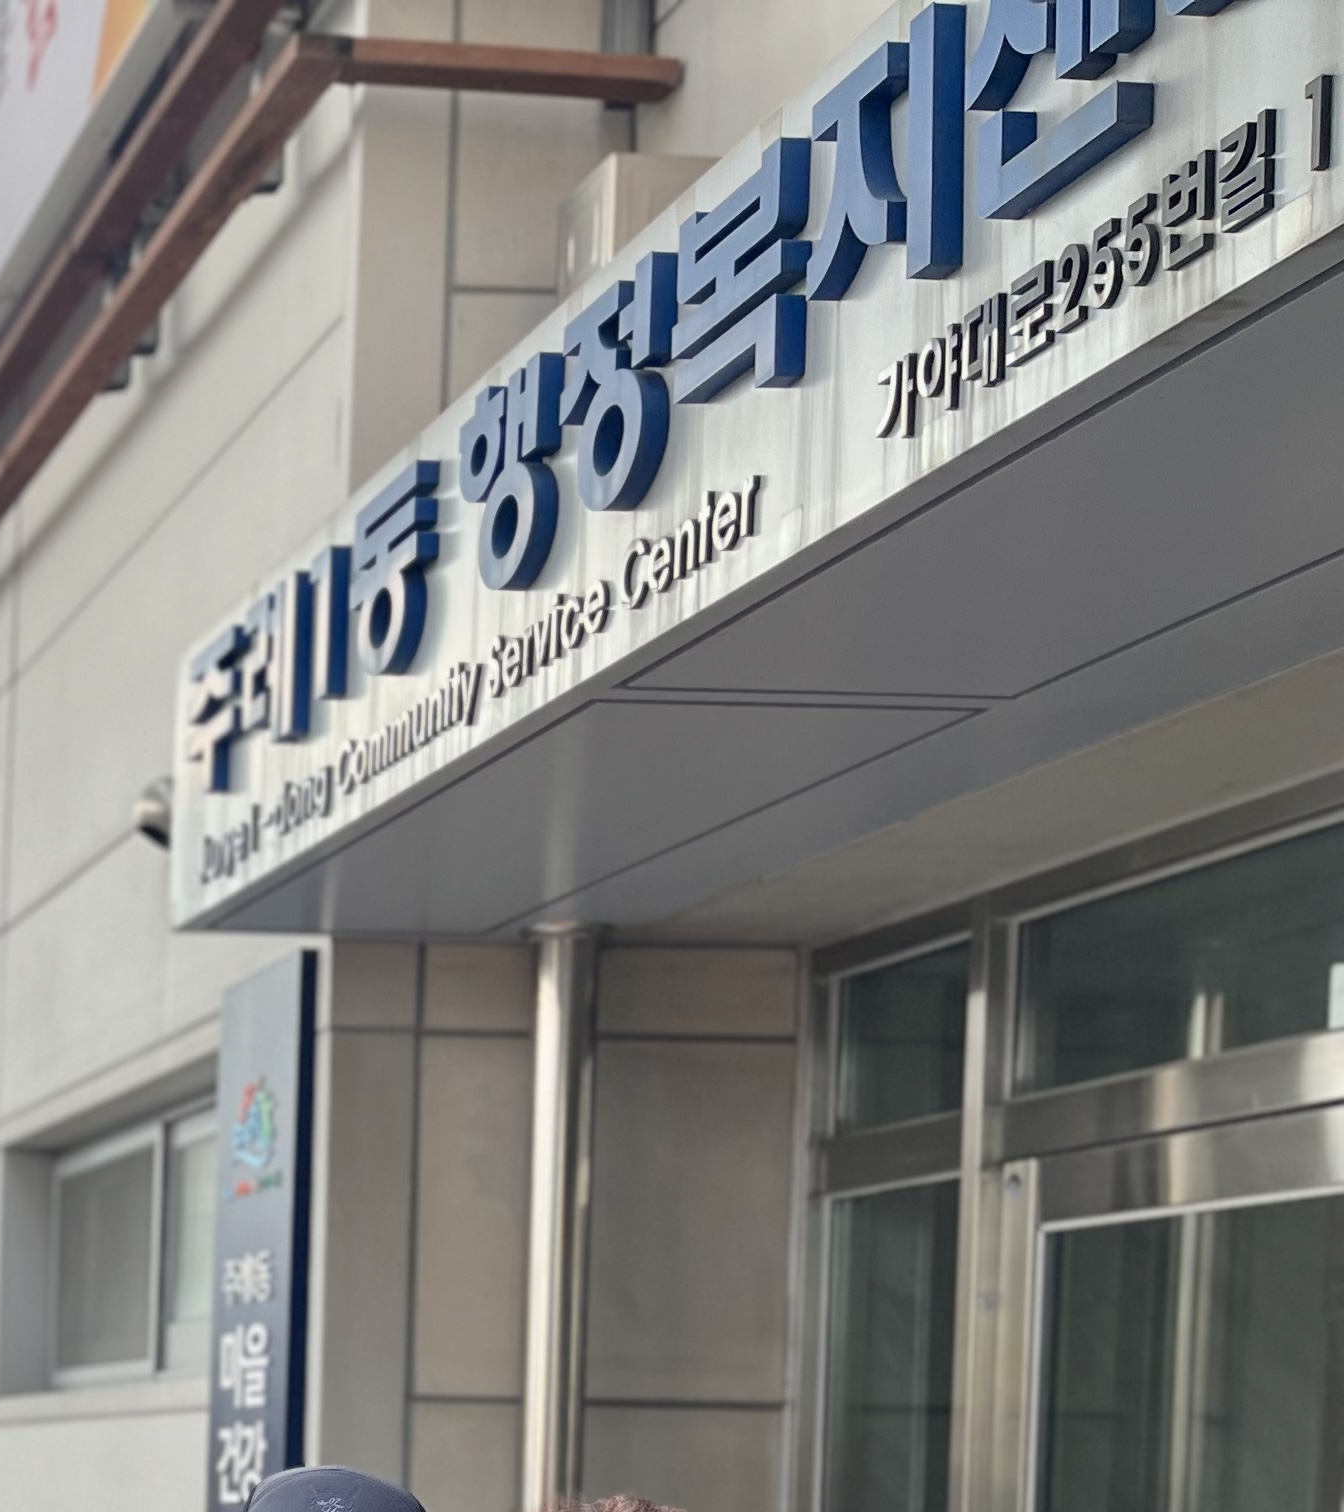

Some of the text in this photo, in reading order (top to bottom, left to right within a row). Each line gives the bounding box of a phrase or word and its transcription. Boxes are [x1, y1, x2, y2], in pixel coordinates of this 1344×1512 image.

[188, 460, 440, 792] 주례1동
[460, 0, 1154, 590] 행정복지센
[876, 109, 1277, 438] 가야대로255번길
[337, 662, 481, 792] Community
[487, 579, 611, 697] Service
[622, 474, 767, 609] Center
